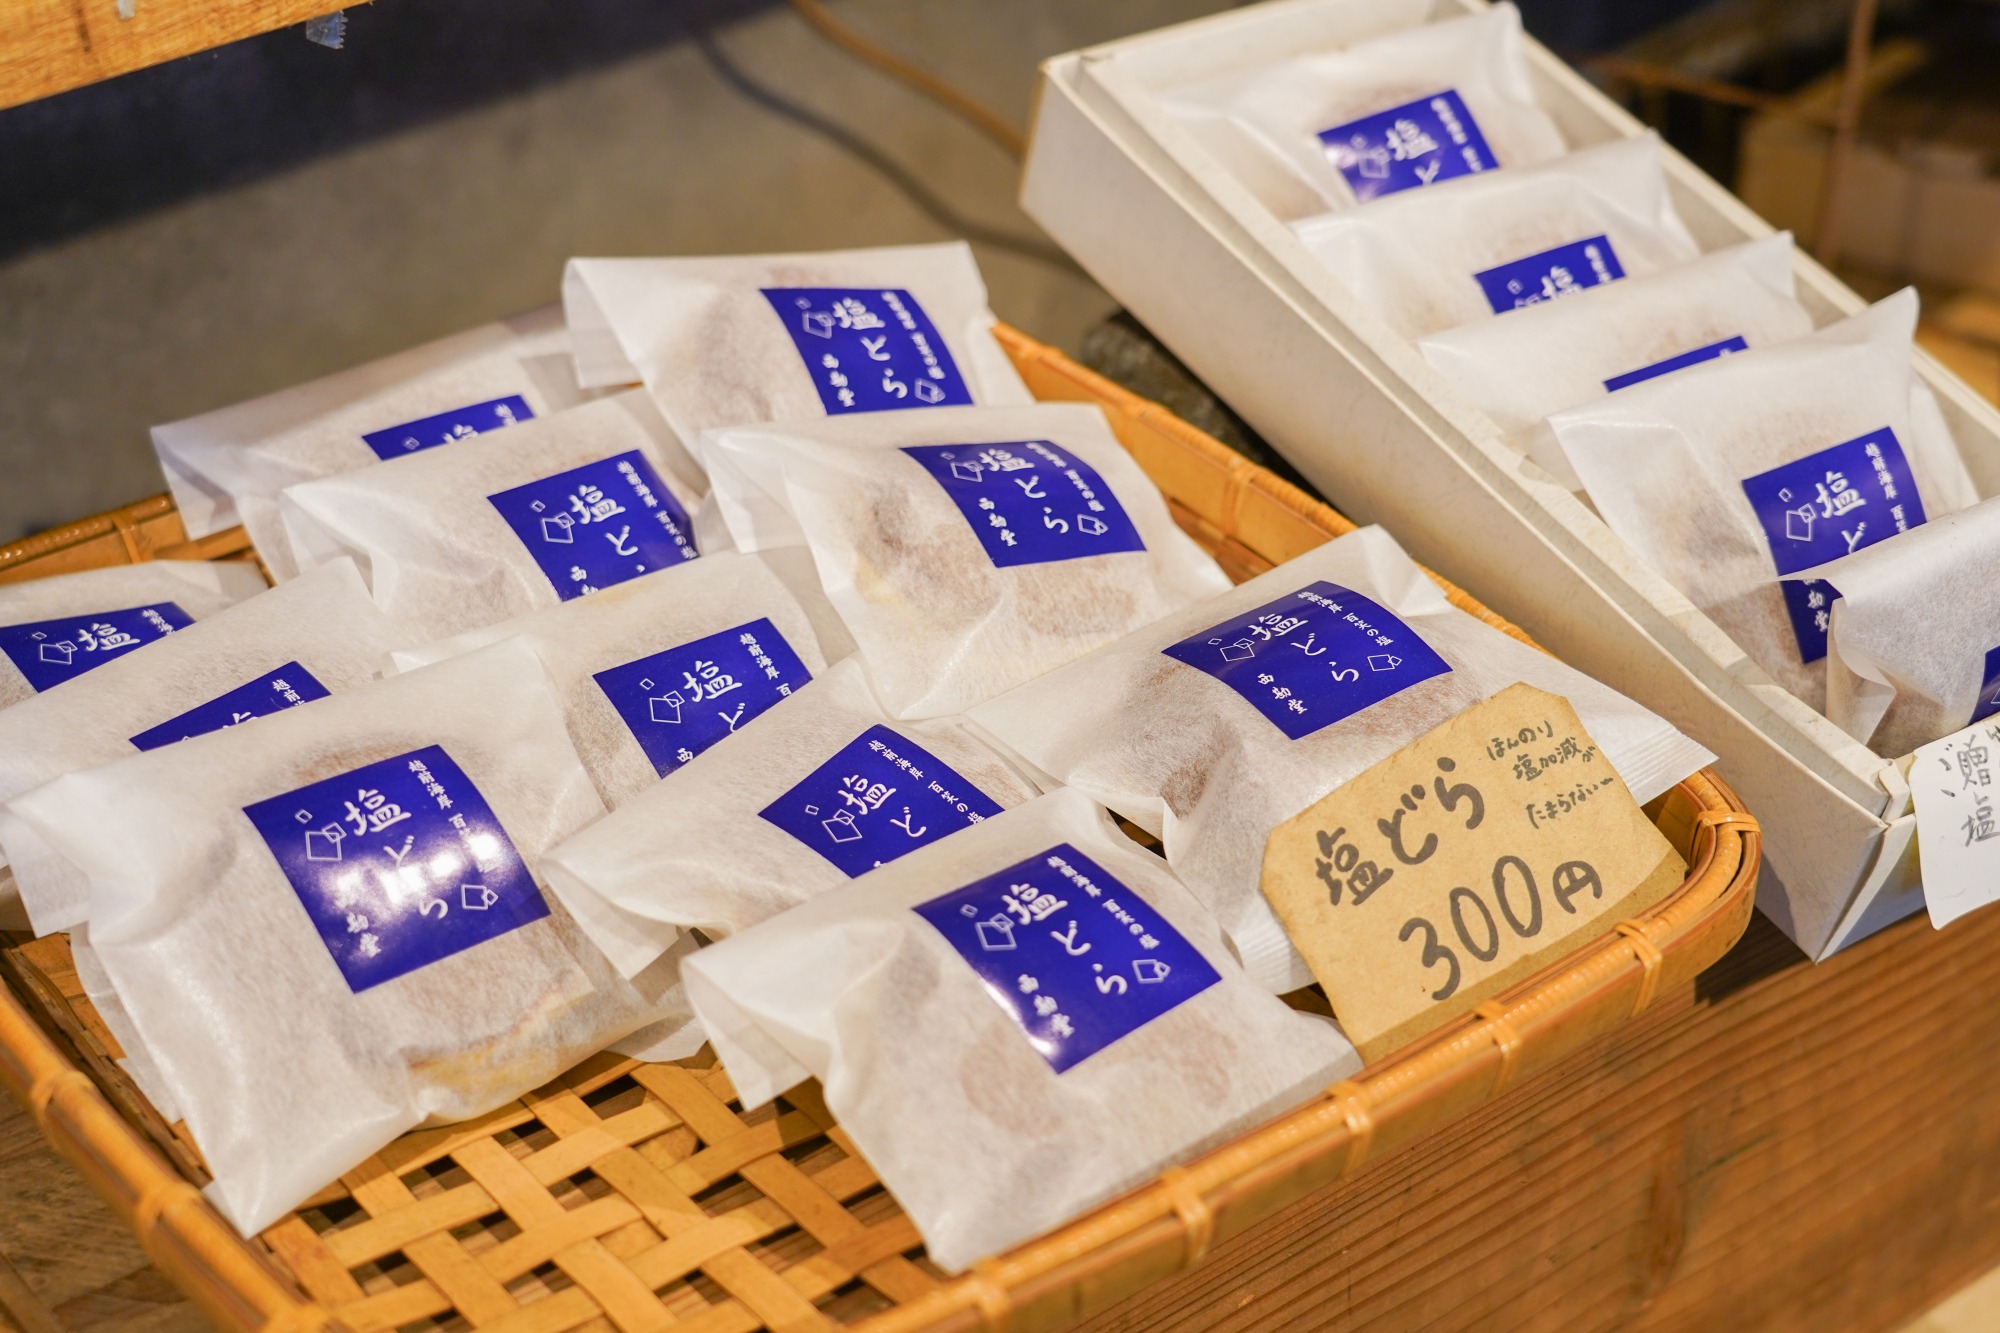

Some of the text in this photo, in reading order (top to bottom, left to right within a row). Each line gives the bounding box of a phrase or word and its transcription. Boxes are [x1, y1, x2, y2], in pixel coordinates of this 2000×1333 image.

[78, 622, 141, 652] 塩
[1248, 613, 1360, 682] 塩どら
[1342, 612, 1394, 648] 百笑の塩
[740, 632, 780, 681] 越前海岸
[271, 679, 306, 707] 越前
[1257, 673, 1308, 715] 西勘堂
[868, 739, 925, 781] 越前海岸
[1487, 720, 1553, 761] ほんのり
[1513, 736, 1596, 781] 塩加減が
[1938, 724, 2000, 798] ご贈
[408, 759, 453, 810] 越前海岸
[1314, 756, 1486, 907] 塩どら
[1001, 883, 1128, 996] 塩どら
[1398, 855, 1603, 1001] 300円
